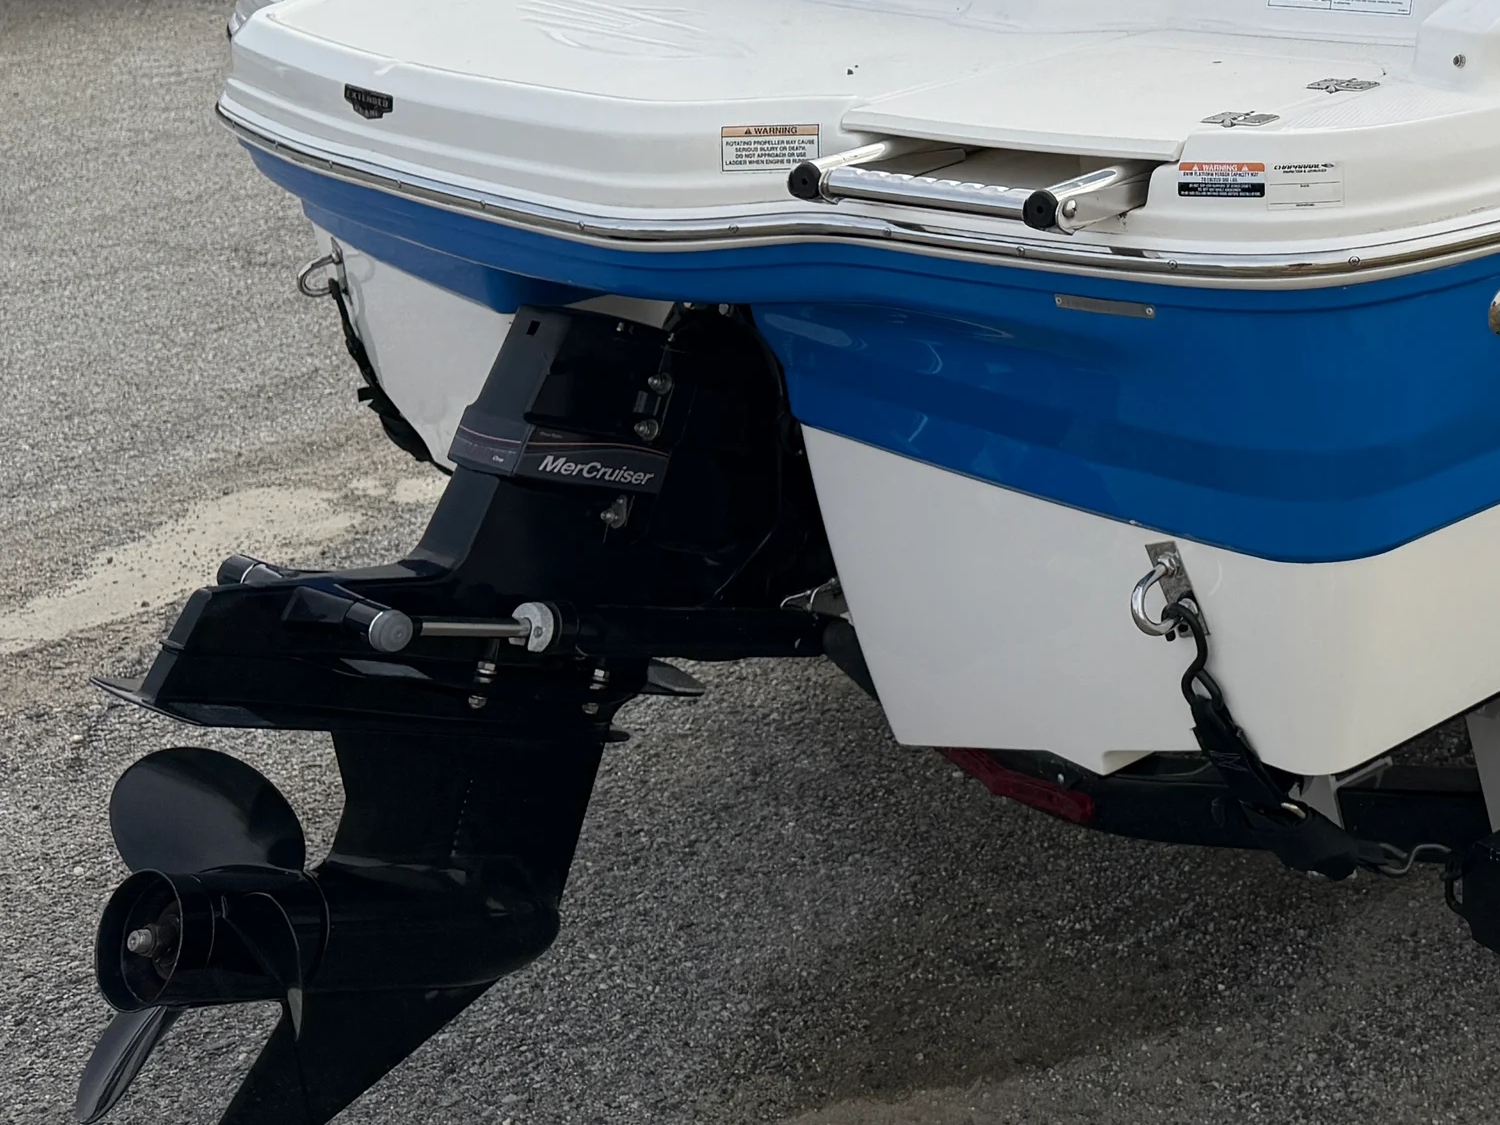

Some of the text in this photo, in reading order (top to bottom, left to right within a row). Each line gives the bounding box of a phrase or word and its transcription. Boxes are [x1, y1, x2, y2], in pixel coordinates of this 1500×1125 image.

[754, 127, 798, 135] WARNING
[1202, 164, 1238, 172] WARNING
[538, 455, 655, 486] MerCruiser
